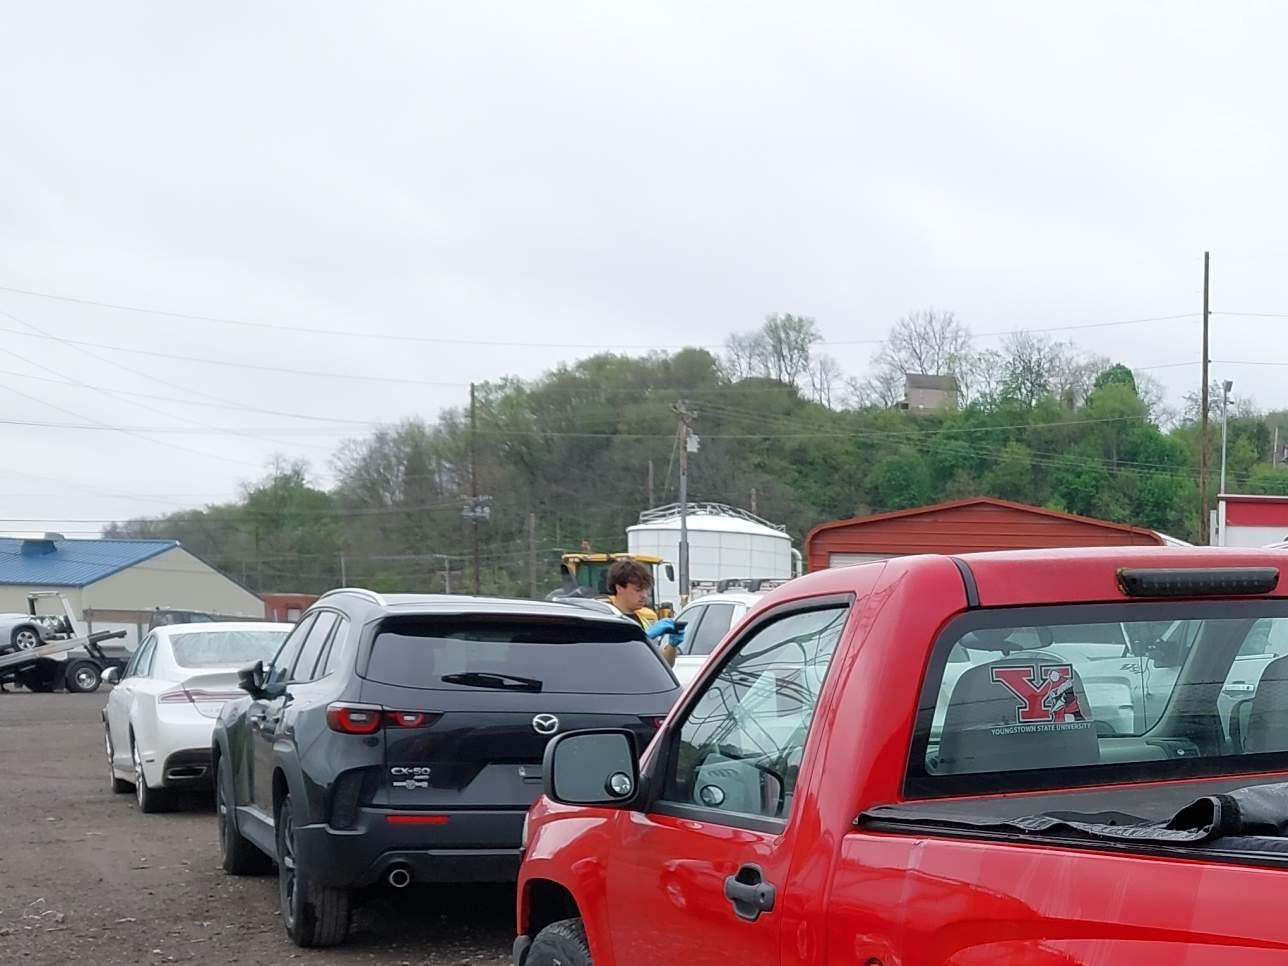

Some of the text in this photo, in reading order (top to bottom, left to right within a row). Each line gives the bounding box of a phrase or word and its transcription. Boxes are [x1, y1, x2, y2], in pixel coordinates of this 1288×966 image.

[991, 722, 1092, 737] YOUNGSTOWN STATE UNIVERSITY
[391, 767, 431, 775] CX-50
